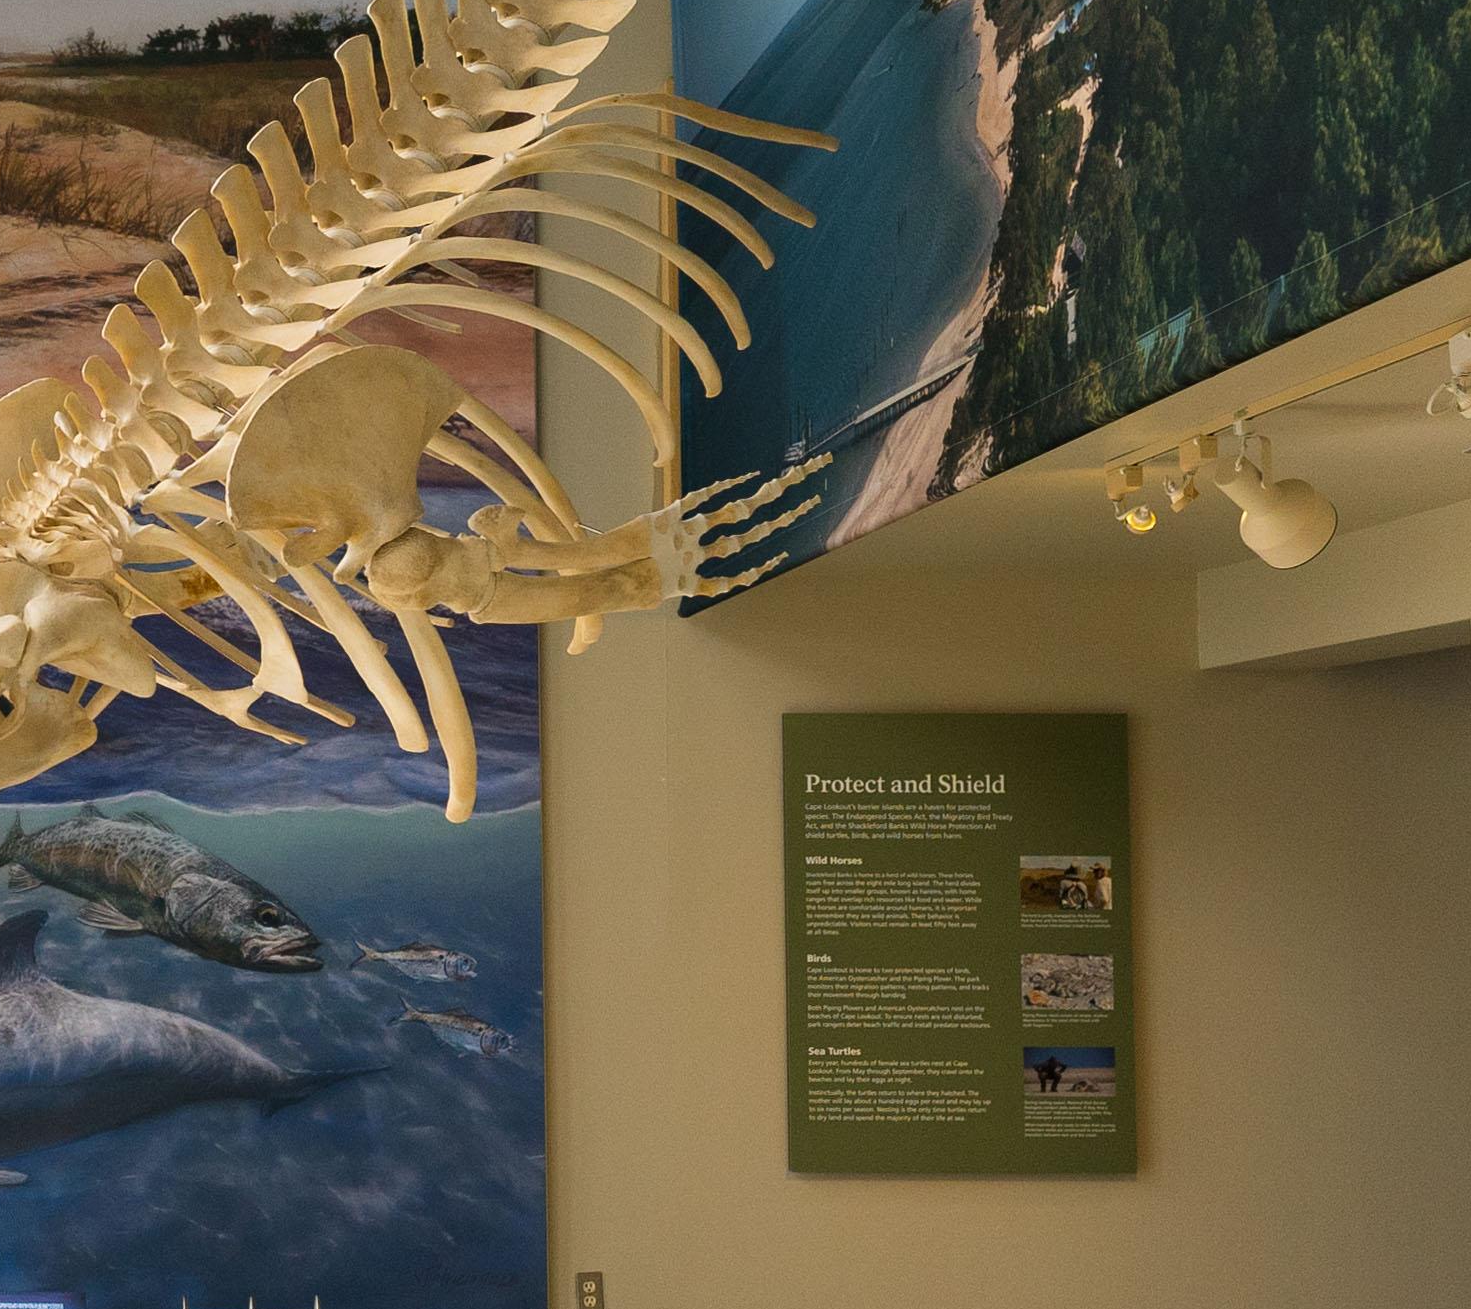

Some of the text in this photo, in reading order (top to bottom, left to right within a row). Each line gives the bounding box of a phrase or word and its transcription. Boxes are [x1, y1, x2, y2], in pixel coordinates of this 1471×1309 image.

[805, 773, 1006, 793] Protect and Shield
[805, 856, 863, 865] Wild Horses
[806, 954, 832, 963] Birds
[808, 1046, 862, 1056] Sea Turtles
